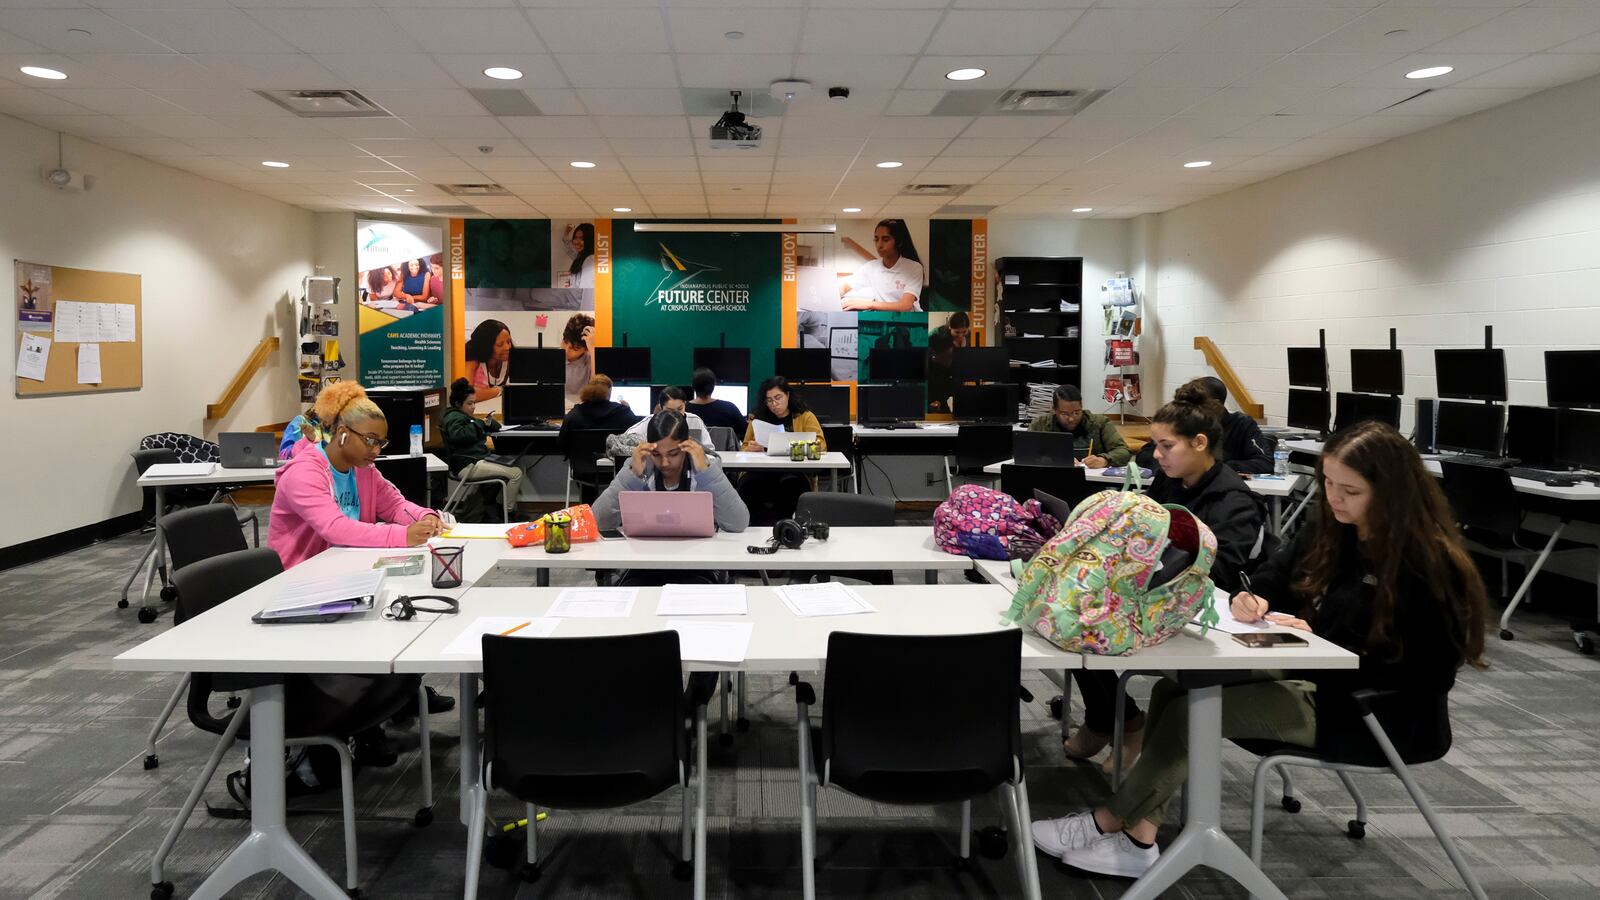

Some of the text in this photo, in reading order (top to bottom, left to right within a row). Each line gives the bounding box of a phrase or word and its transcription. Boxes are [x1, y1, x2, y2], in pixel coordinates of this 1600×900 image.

[451, 233, 463, 280] ENROLL
[597, 232, 609, 274] ENLIST
[783, 233, 796, 282] EMPLOY
[658, 290, 750, 304] FUTURE CENTER
[974, 233, 985, 328] FUTURE CENTER
[660, 304, 747, 312] AT CRISPUS ATTUCKS HIGH SCHOOL
